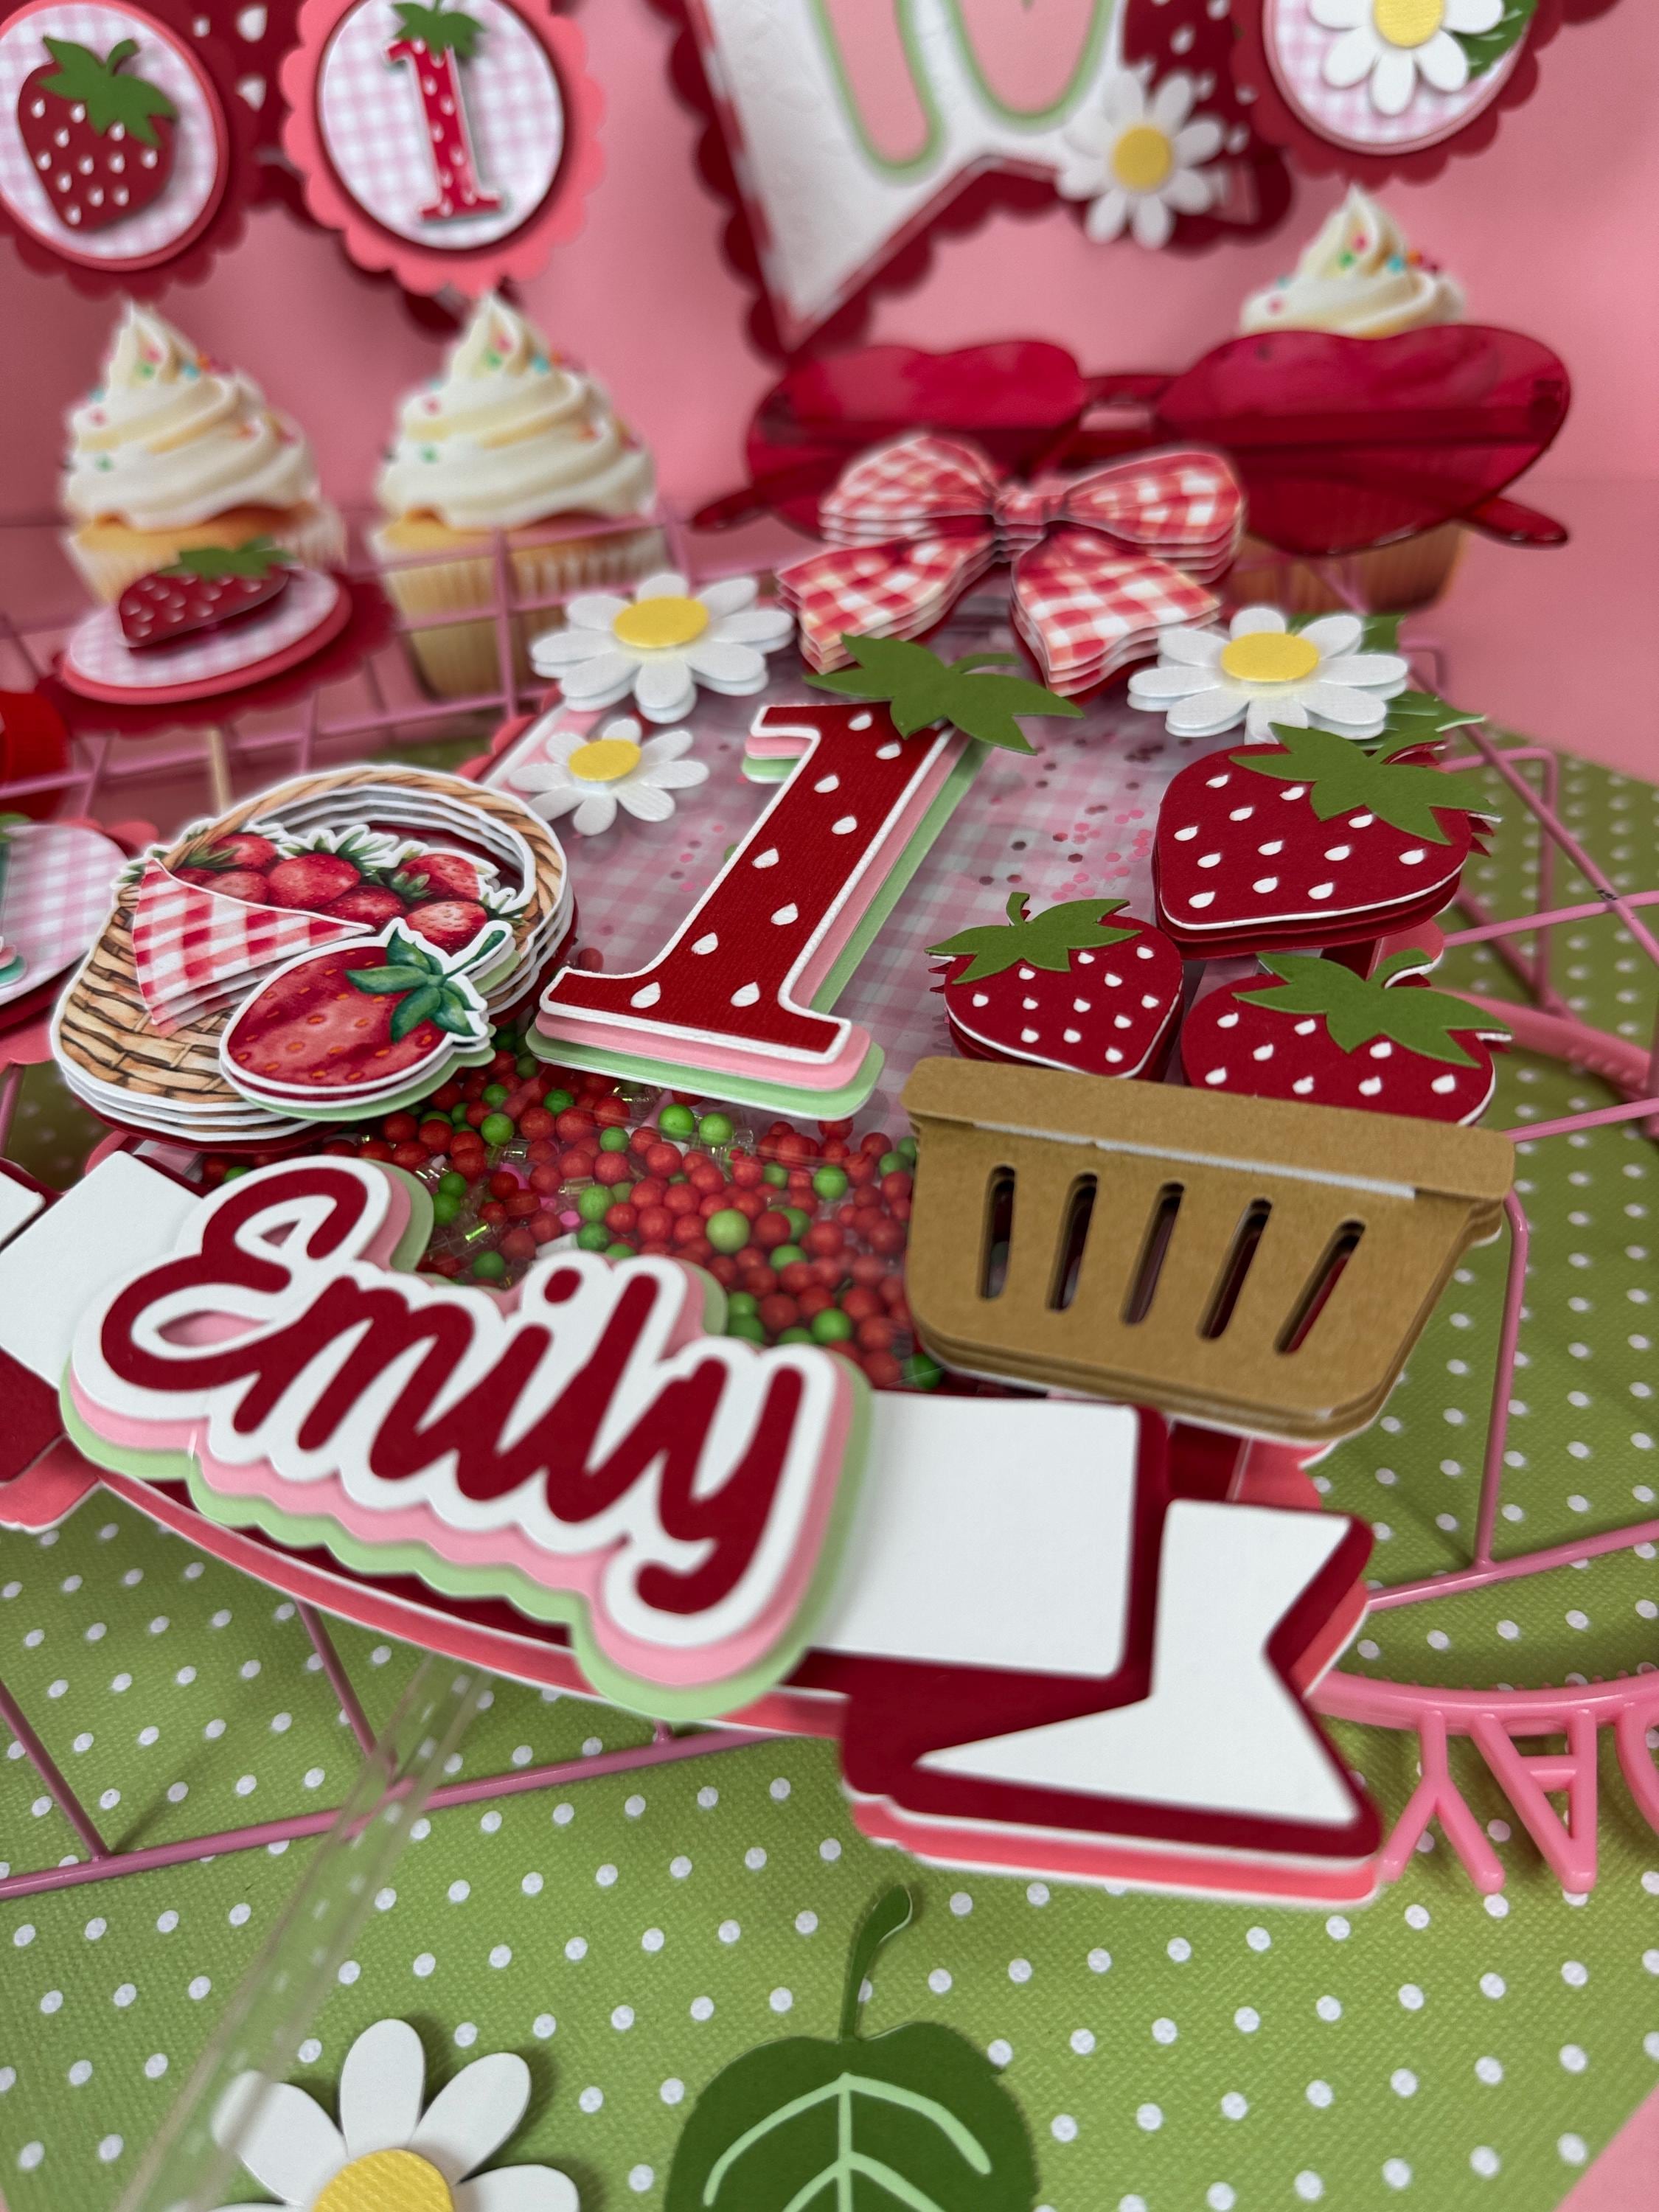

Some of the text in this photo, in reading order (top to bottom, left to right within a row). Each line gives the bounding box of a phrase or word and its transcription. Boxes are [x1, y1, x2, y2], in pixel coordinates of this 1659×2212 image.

[386, 37, 503, 220] 1
[540, 702, 953, 1064] 1
[100, 1166, 805, 1615] Emily
